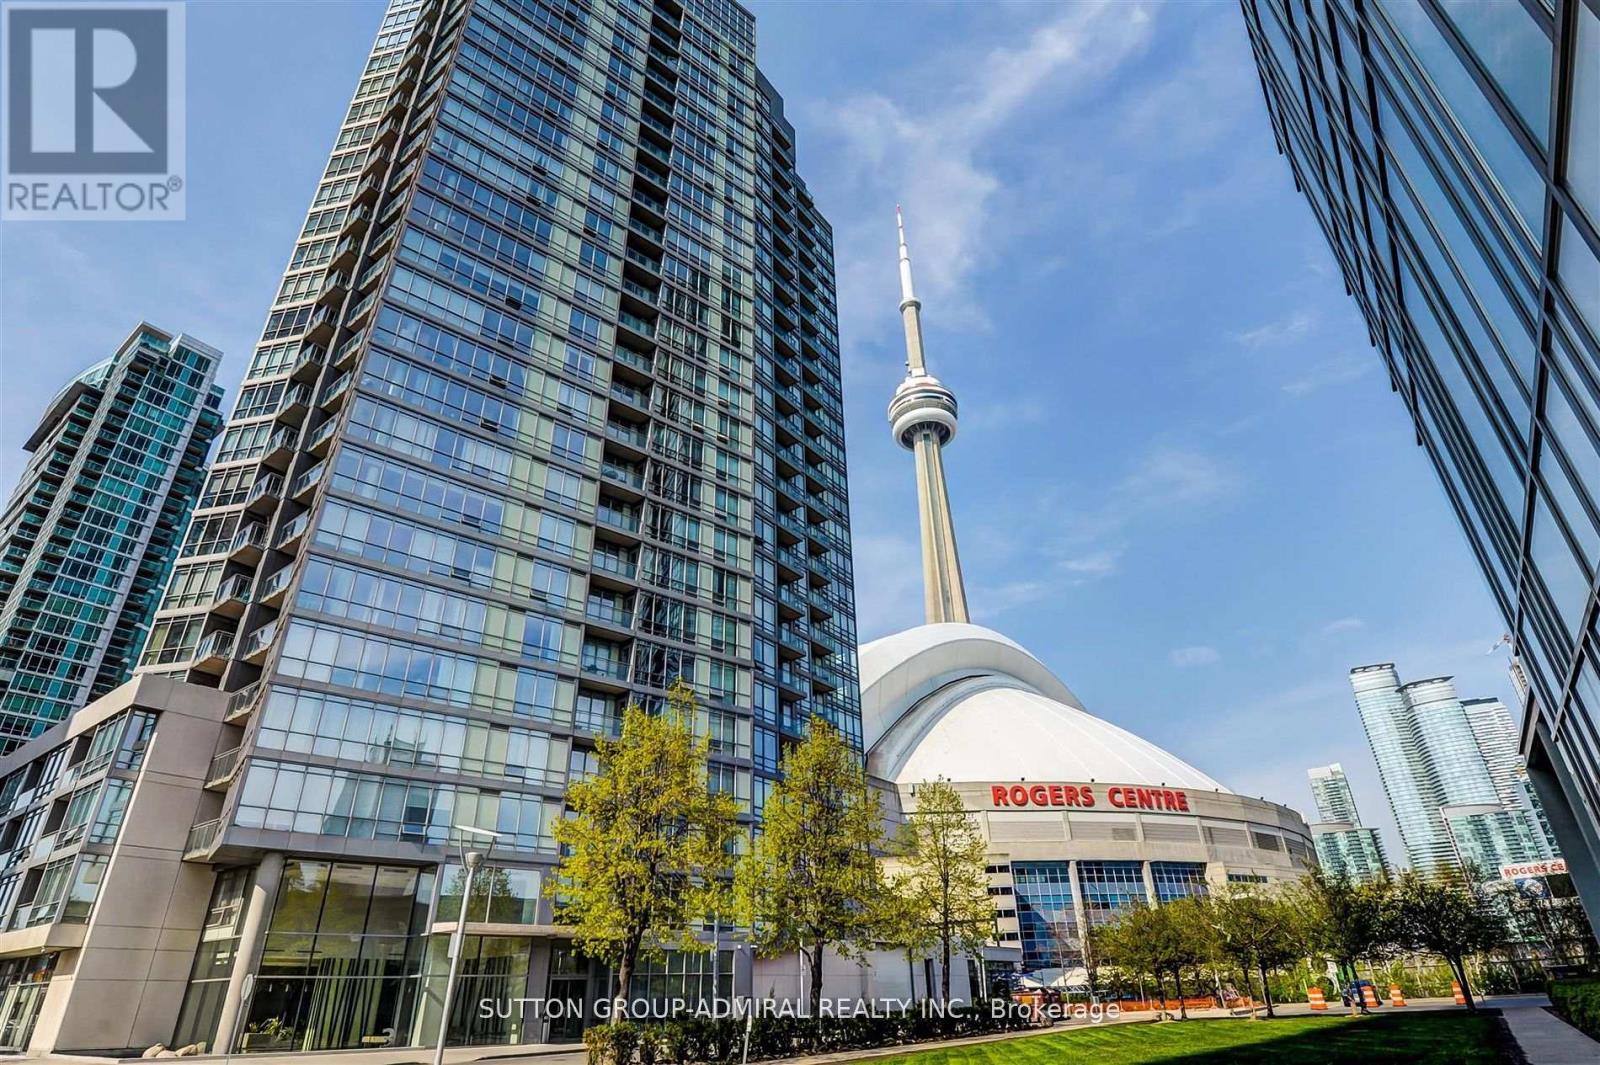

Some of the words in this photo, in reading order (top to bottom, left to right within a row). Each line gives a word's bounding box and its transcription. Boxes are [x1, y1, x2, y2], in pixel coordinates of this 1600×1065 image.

[991, 785, 1096, 808] ROGERS
[1108, 787, 1190, 812] CENTRE
[1503, 864, 1548, 877] ROGERS
[1550, 863, 1567, 872] CE
